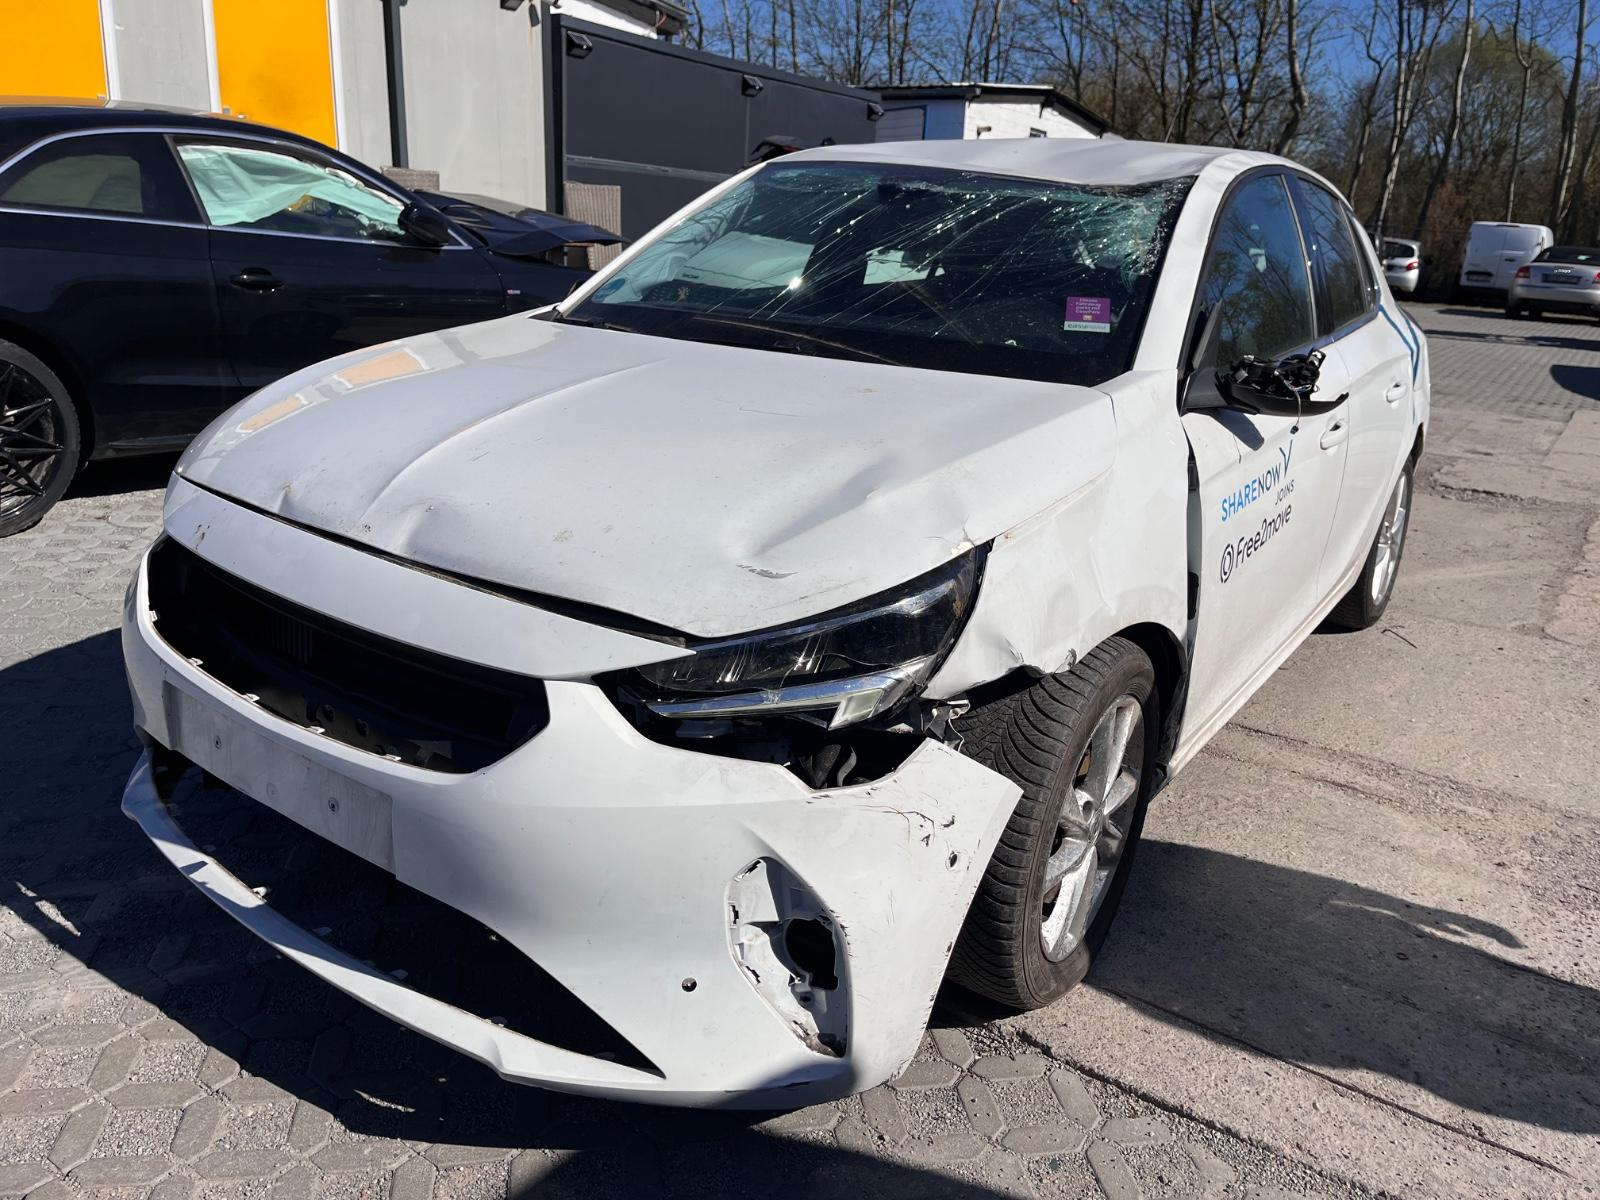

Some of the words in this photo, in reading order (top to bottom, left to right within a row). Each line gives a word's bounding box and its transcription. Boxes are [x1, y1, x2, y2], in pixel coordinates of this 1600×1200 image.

[1221, 462, 1281, 522] SHARENOW
[1275, 480, 1295, 506] JOINS
[1236, 504, 1292, 569] Free2move
